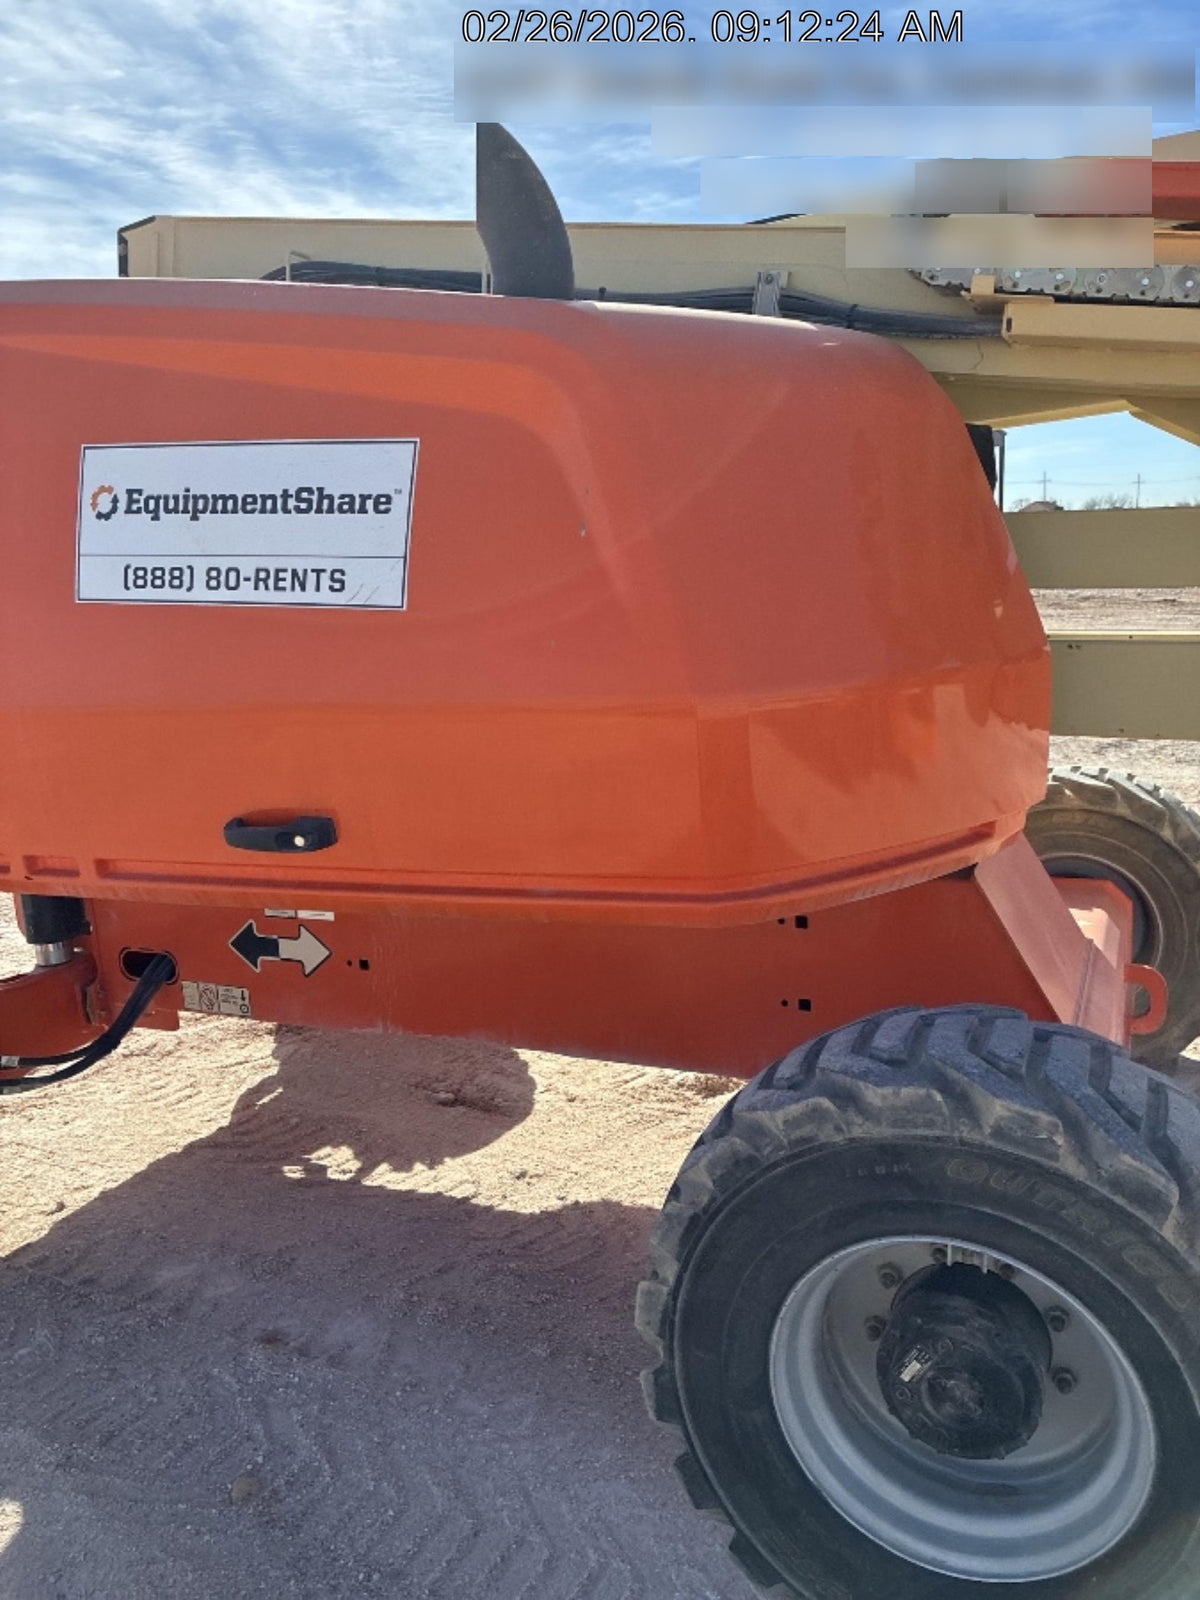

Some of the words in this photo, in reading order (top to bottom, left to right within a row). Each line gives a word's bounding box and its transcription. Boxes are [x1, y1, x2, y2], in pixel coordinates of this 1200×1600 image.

[124, 487, 392, 521] EquipmentShare
[124, 564, 194, 592] (888)
[205, 566, 346, 592] 80-RENTS
